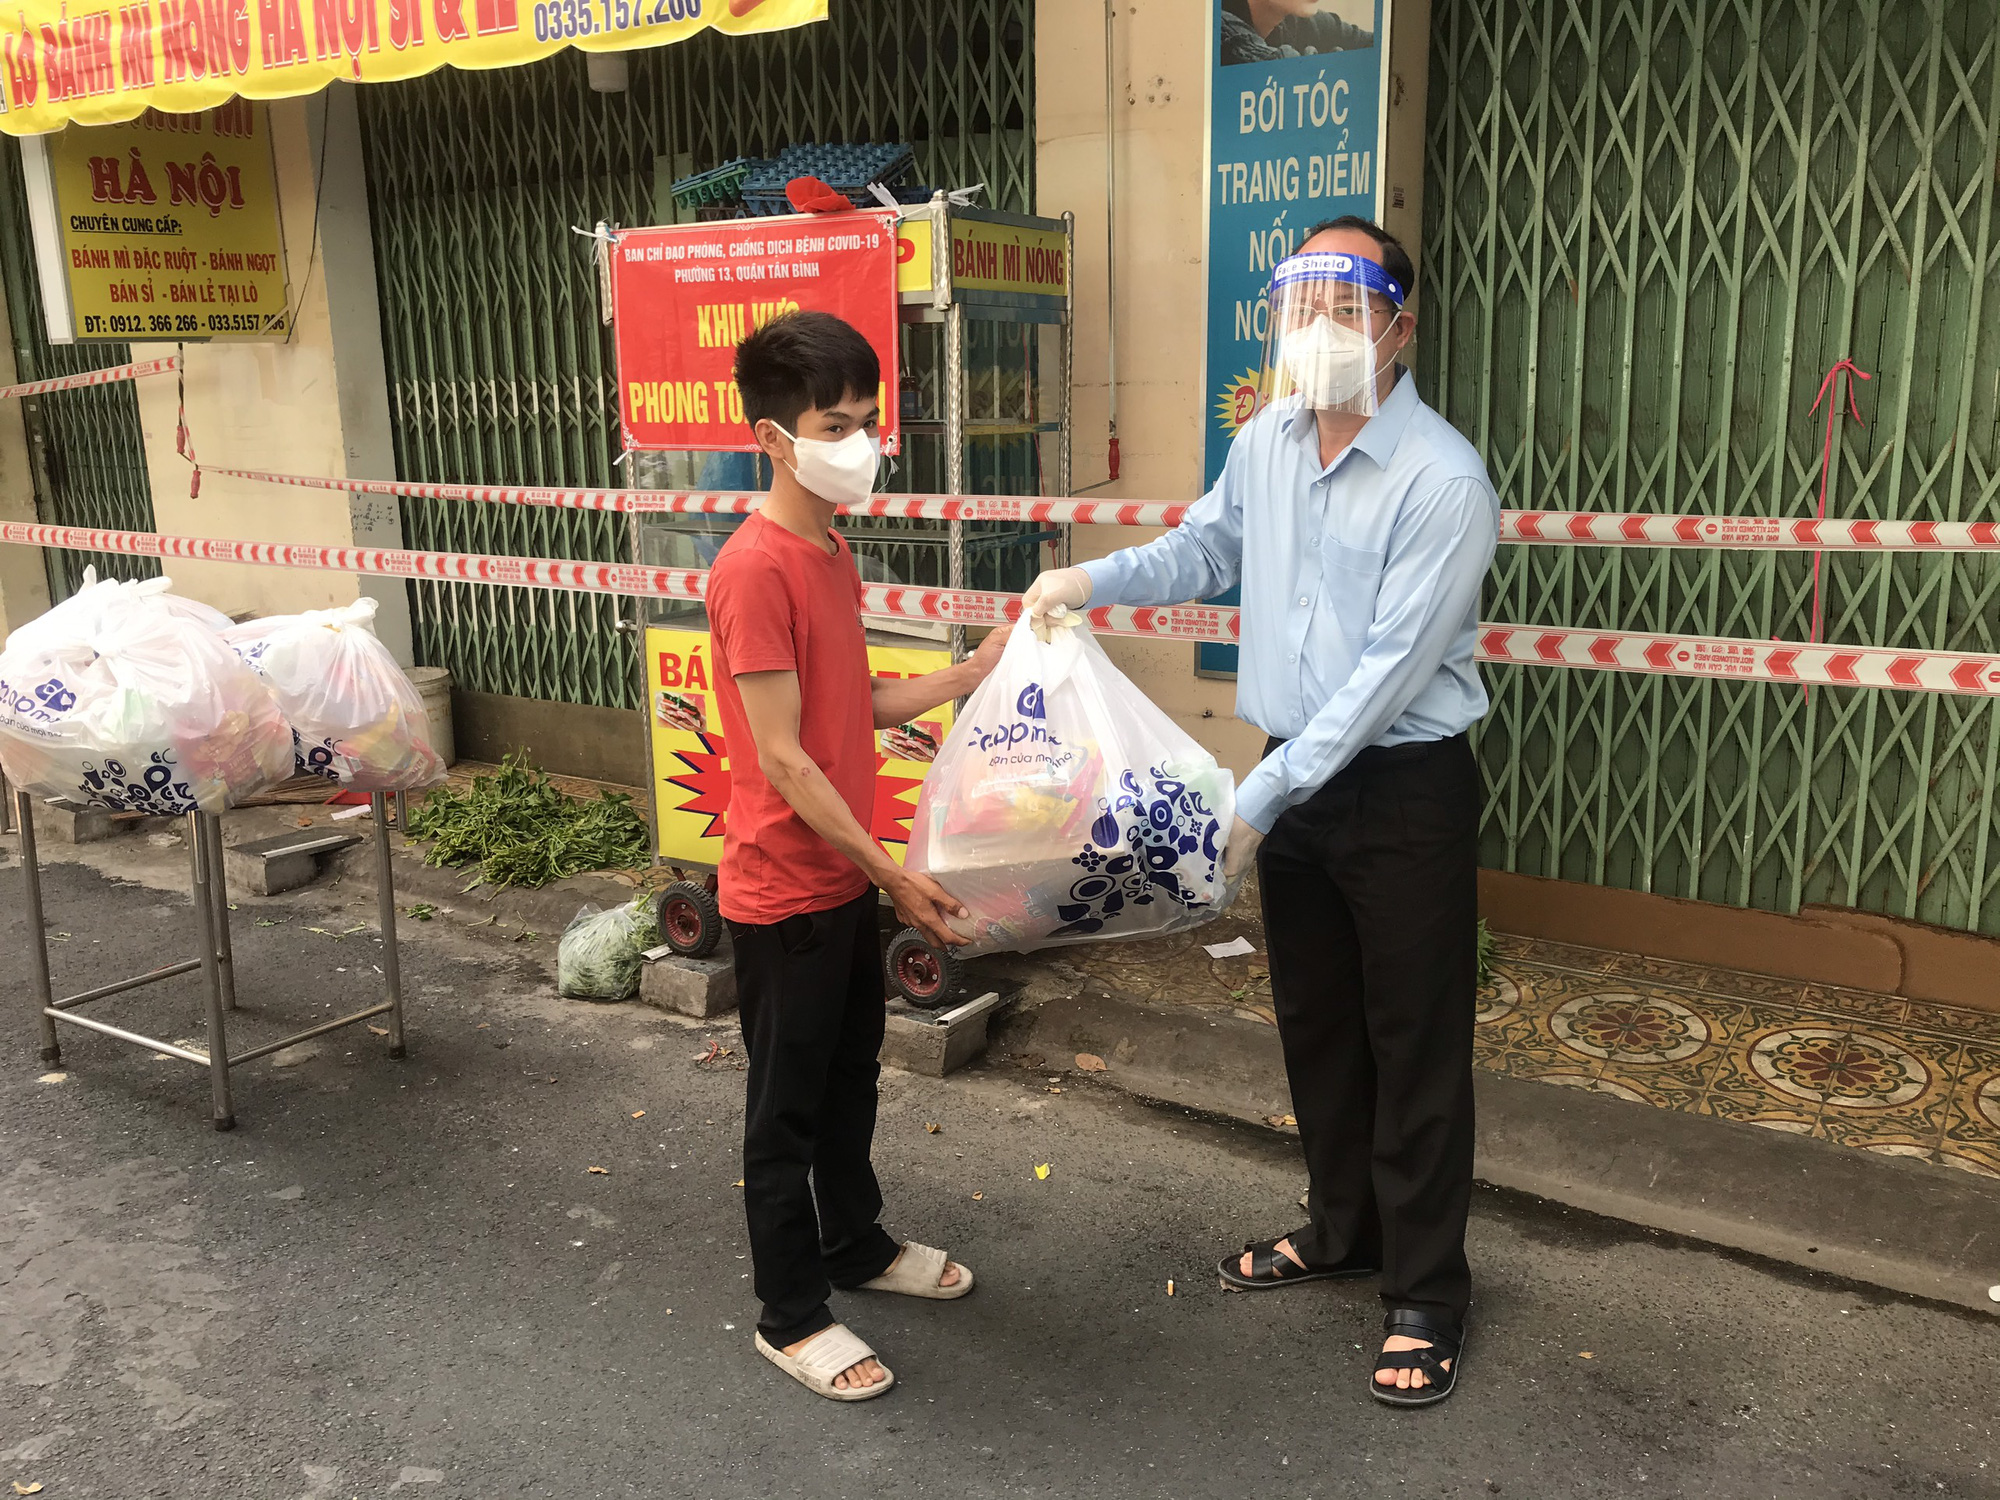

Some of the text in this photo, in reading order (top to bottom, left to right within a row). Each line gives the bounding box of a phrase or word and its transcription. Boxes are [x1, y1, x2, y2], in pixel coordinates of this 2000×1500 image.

[40, 1, 115, 104] BÁNH
[1240, 69, 1349, 134] BỚI TÓC
[88, 147, 246, 217] HÀ NỘI
[1217, 128, 1370, 205] TRANG ĐIỂM
[70, 213, 182, 233] CHUYÊN CUNG CẤP:
[72, 244, 110, 268] BÁNH
[113, 245, 131, 269] MÌ
[133, 246, 161, 274] ĐẶC
[164, 247, 197, 274] RUỘT
[209, 248, 243, 271] BÁNH
[246, 254, 276, 275] NGỌT
[624, 233, 879, 263] BAN CHỈ ĐẠO PHÒNG, CHỐNG DỊCH BỆNH COVID-19
[954, 229, 1064, 286] BÁNH MÌ NÓNG
[675, 260, 820, 283] PHƯỜNG 13, QUẬN TÂN BÌNH
[1277, 260, 1346, 277] Face Shield
[109, 279, 138, 303] BÁN
[141, 277, 155, 303] SỈ
[170, 279, 197, 303] BÁN
[199, 278, 215, 303] LẺ
[218, 284, 240, 306] TẠI
[242, 280, 258, 303] LÒ
[84, 315, 107, 332] ĐT:
[110, 315, 146, 332] 0912.
[148, 314, 172, 332] 366
[175, 314, 198, 331] 266
[208, 314, 260, 331] 033.5157
[697, 304, 744, 348] KHU
[628, 381, 708, 424] PHONG
[1739, 665, 1753, 673] KHU
